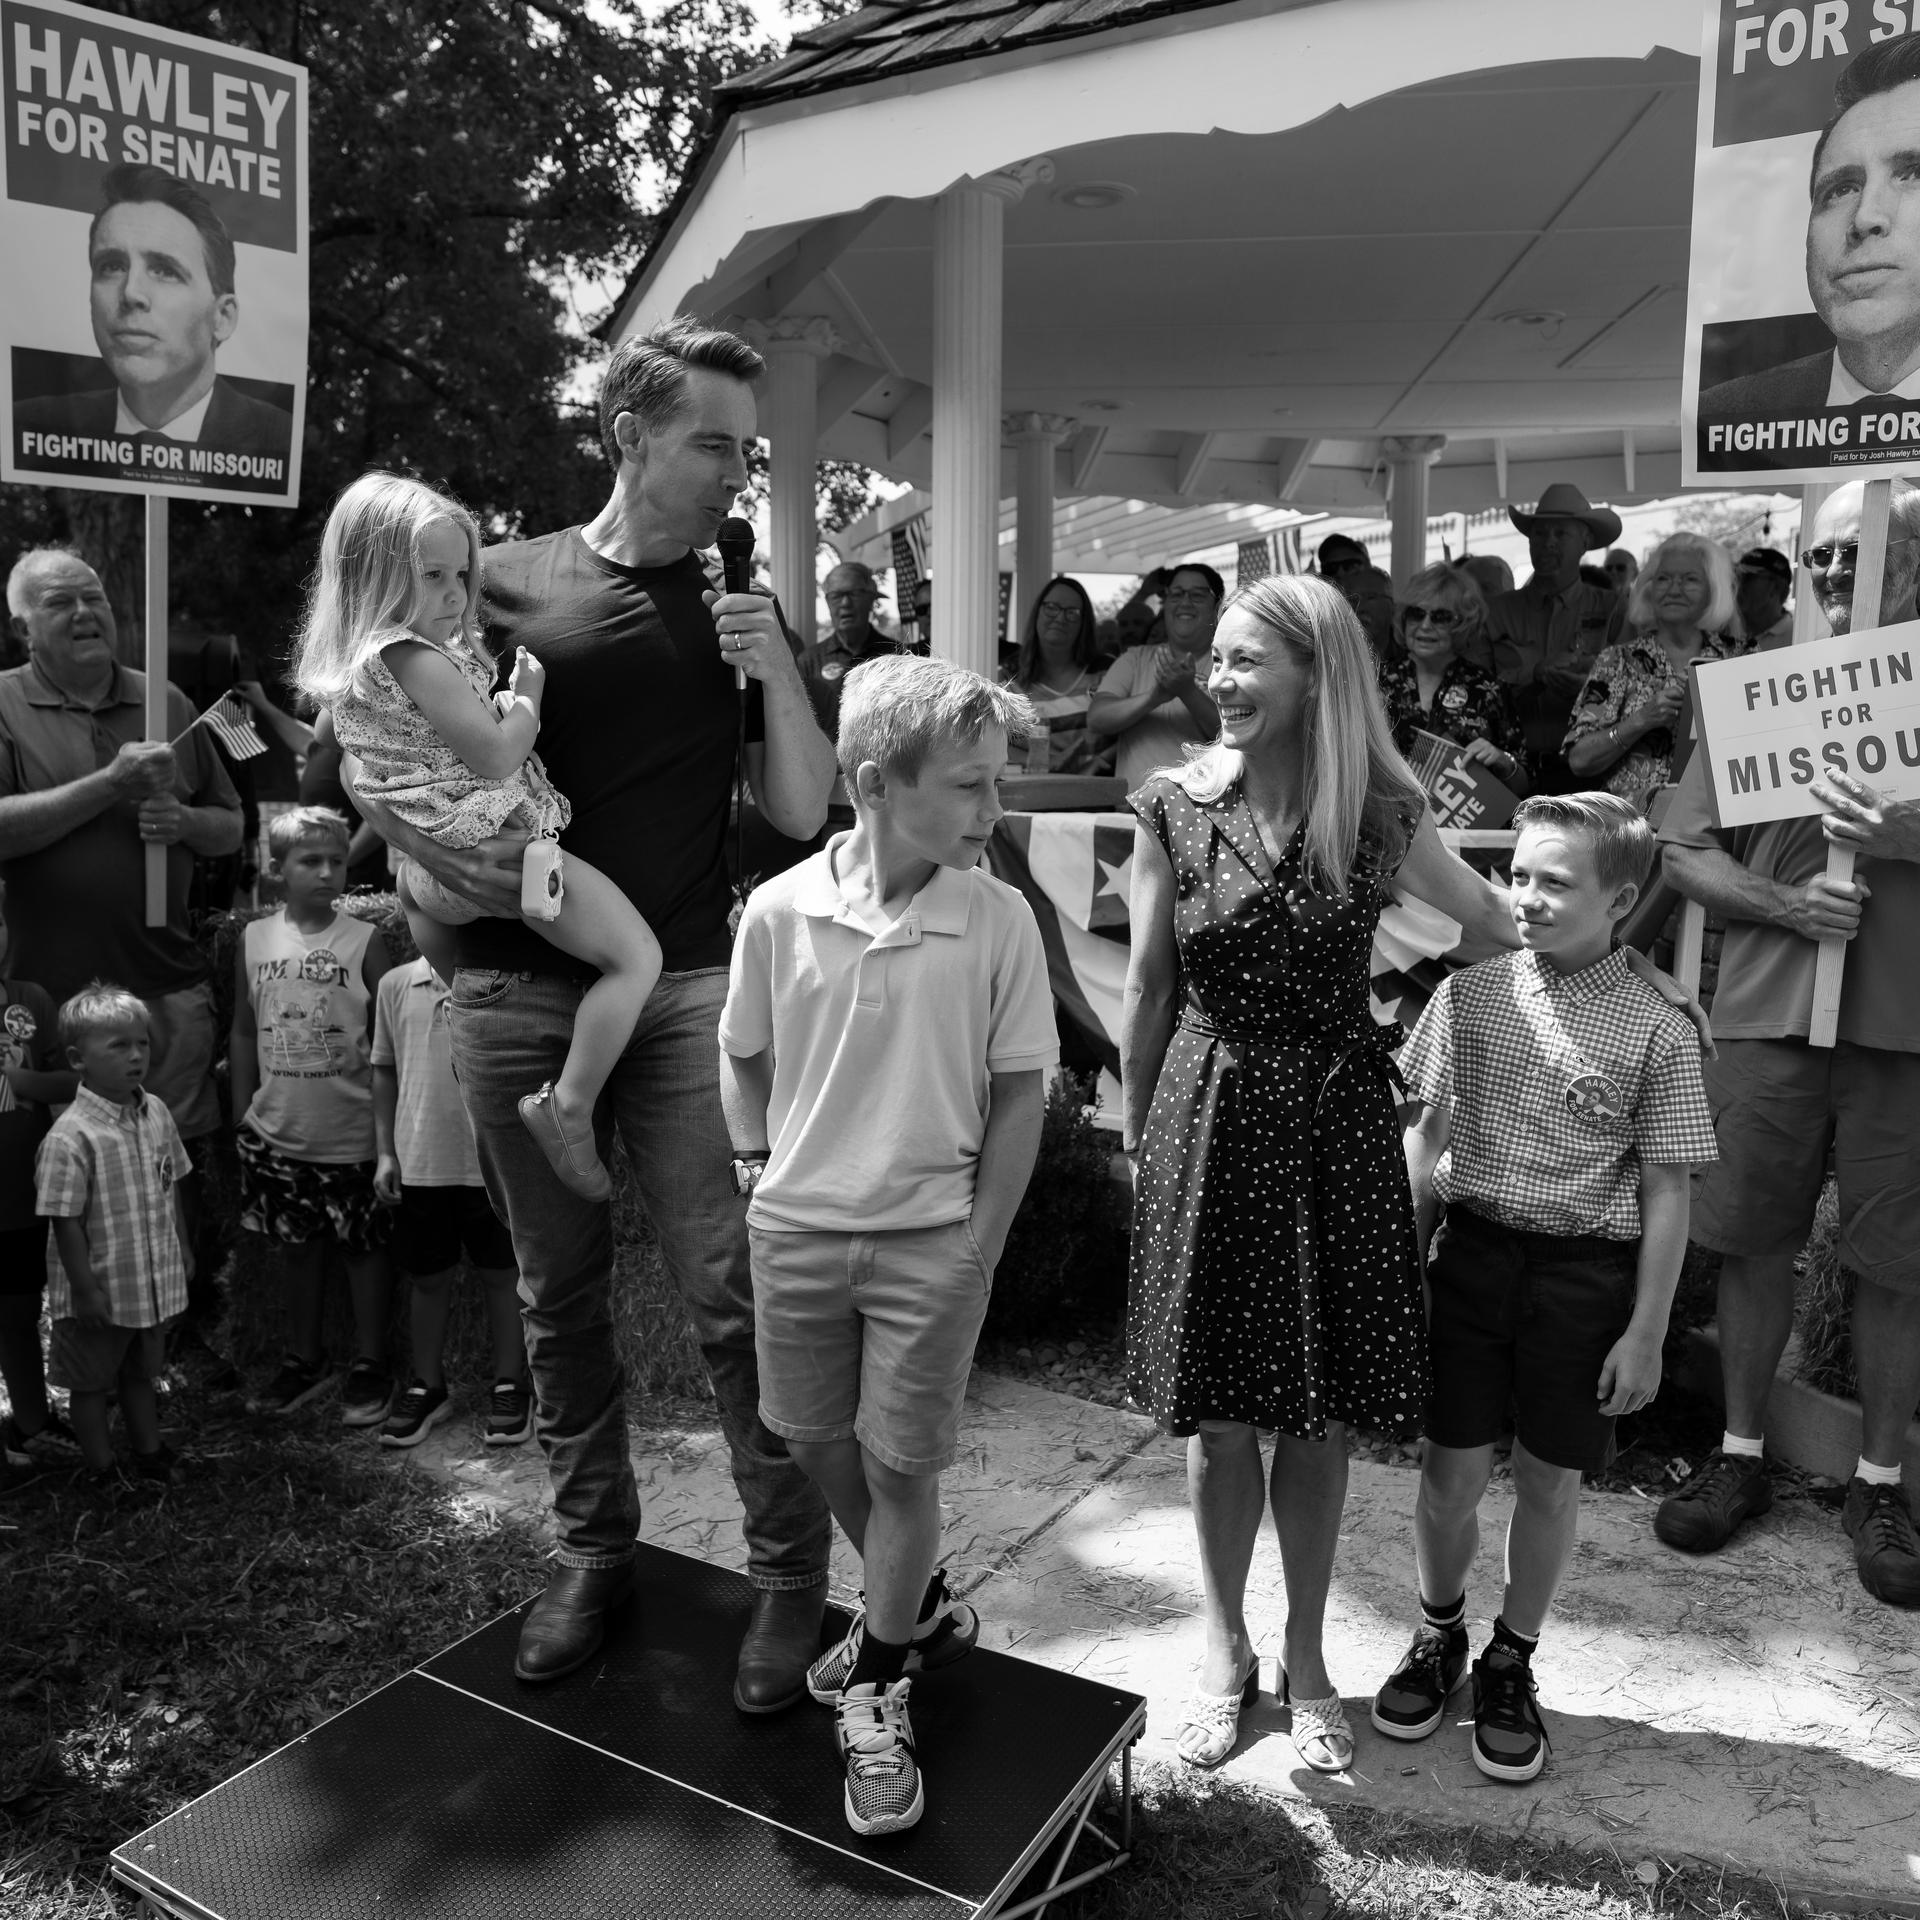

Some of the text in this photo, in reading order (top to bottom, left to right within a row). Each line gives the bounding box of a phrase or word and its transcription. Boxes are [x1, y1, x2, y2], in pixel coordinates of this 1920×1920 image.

[1733, 0, 1849, 75] FOR
[14, 22, 291, 150] HAWLEY
[17, 101, 281, 199] FOR SENATE
[1708, 410, 1920, 452] FIGHTING FOR
[22, 432, 283, 480] FIGHTING FOR MISSOURI
[1833, 453, 1848, 461] Paid
[1850, 452, 1858, 460] for
[1860, 452, 1868, 461] by
[1869, 451, 1885, 459] Josh
[1886, 449, 1911, 458] Hawley
[1821, 703, 1873, 729] FOR
[303, 1068, 343, 1079] ENERGY
[1584, 1079, 1618, 1103] HAWLEY
[1568, 1099, 1602, 1122] FOR SENATE
